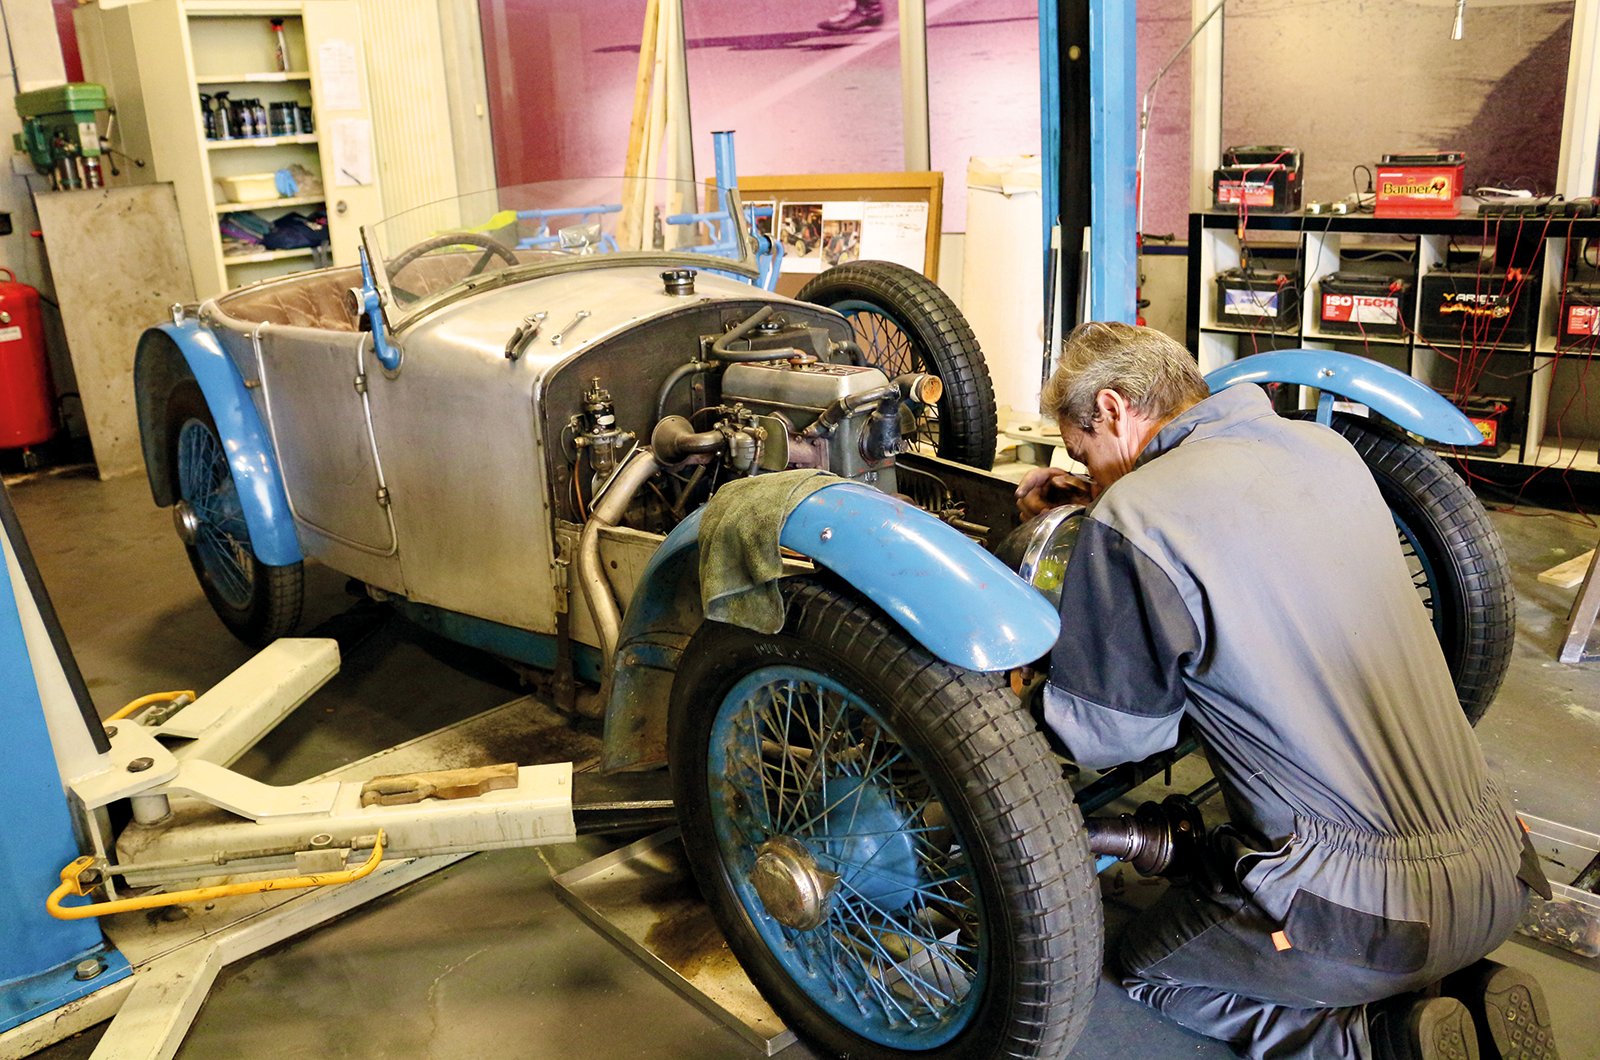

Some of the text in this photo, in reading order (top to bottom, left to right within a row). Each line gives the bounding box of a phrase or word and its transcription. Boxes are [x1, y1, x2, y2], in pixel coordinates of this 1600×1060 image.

[1383, 182, 1431, 194] Banner
[1326, 295, 1352, 306] ISO
[1572, 307, 1596, 316] ISO
